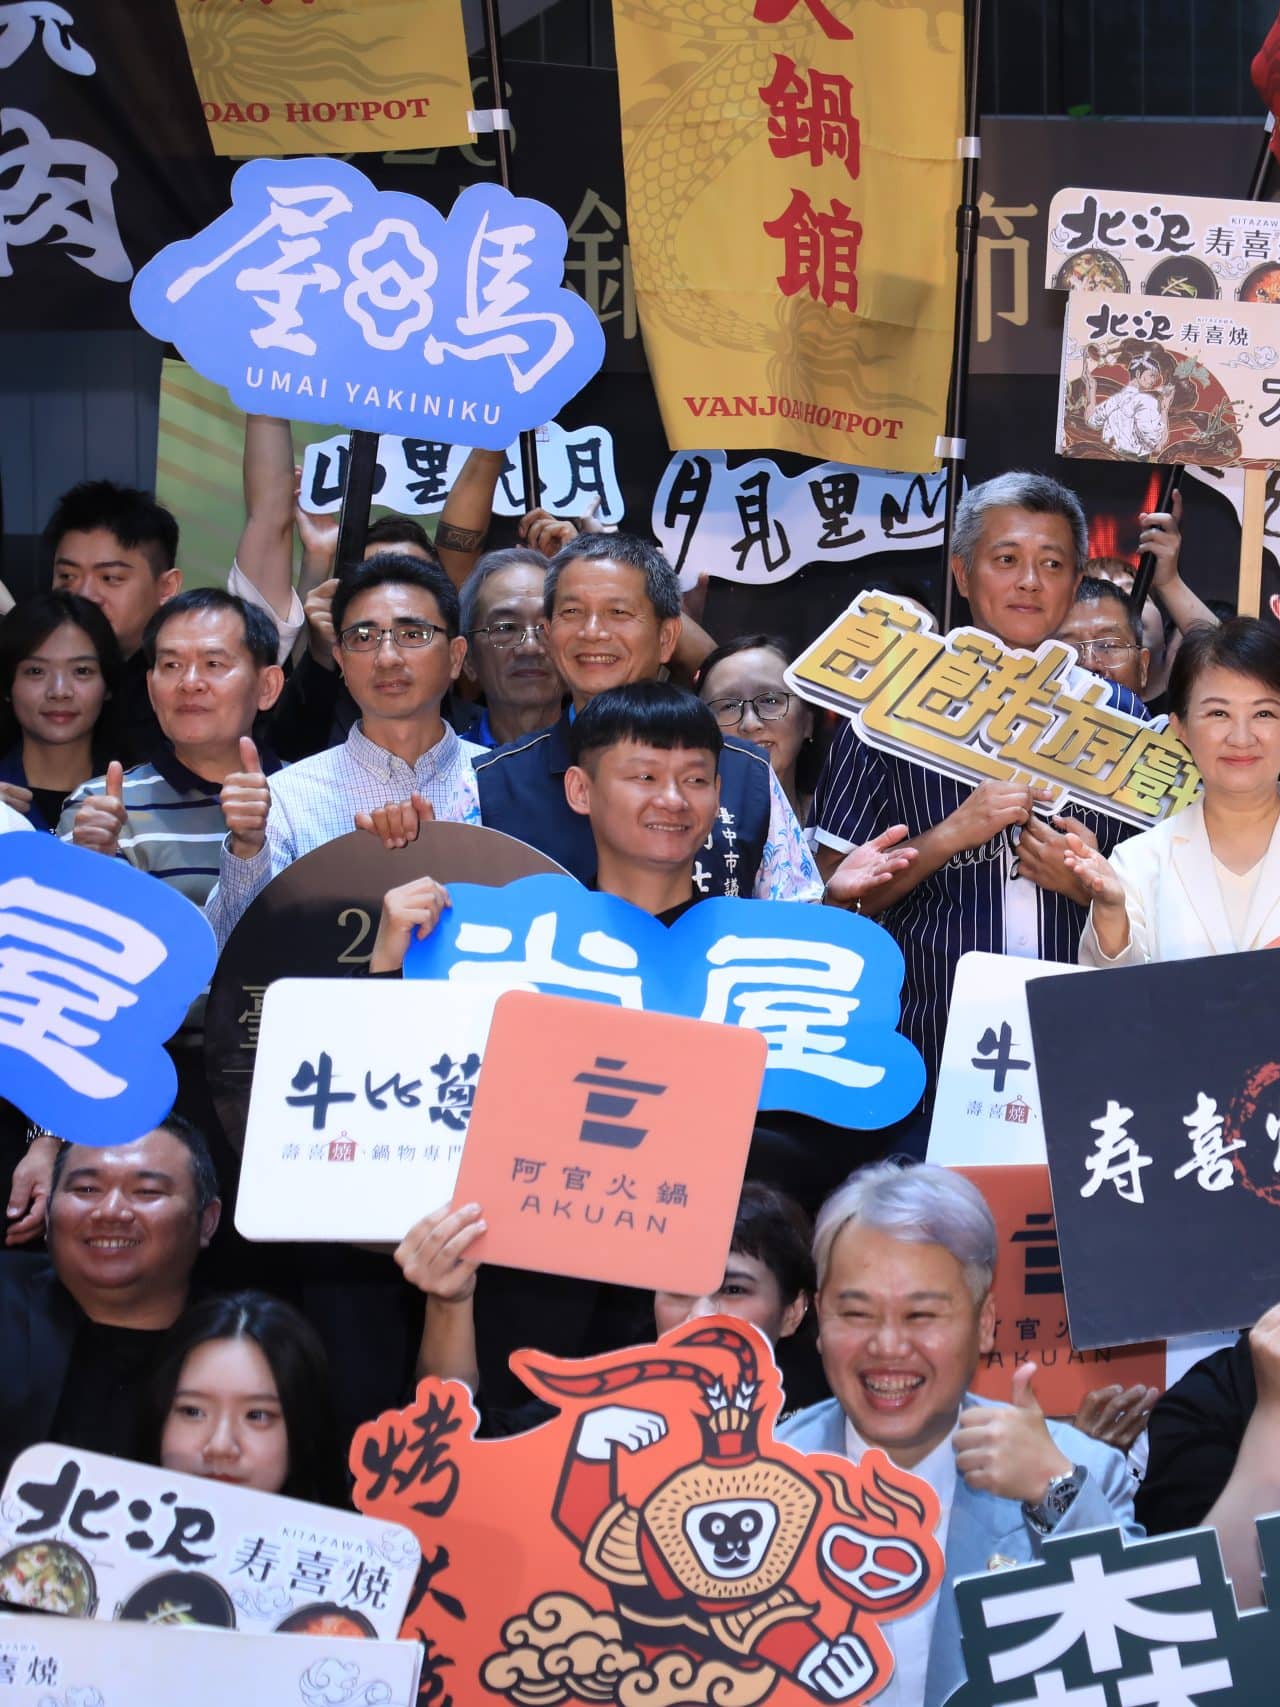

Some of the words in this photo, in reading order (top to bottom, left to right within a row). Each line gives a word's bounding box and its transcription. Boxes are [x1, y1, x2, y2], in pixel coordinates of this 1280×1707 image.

[285, 98, 431, 123] HOTPOT
[1061, 196, 1196, 253] 北沢
[1086, 303, 1173, 340] 北沢
[246, 366, 328, 400] UMAI
[345, 381, 502, 425] YAKINIKU
[804, 404, 904, 439] HOTPOT
[511, 1157, 688, 1208] 阿官火鍋
[520, 1195, 667, 1234] AKUAN
[15, 1460, 217, 1564] 北沢
